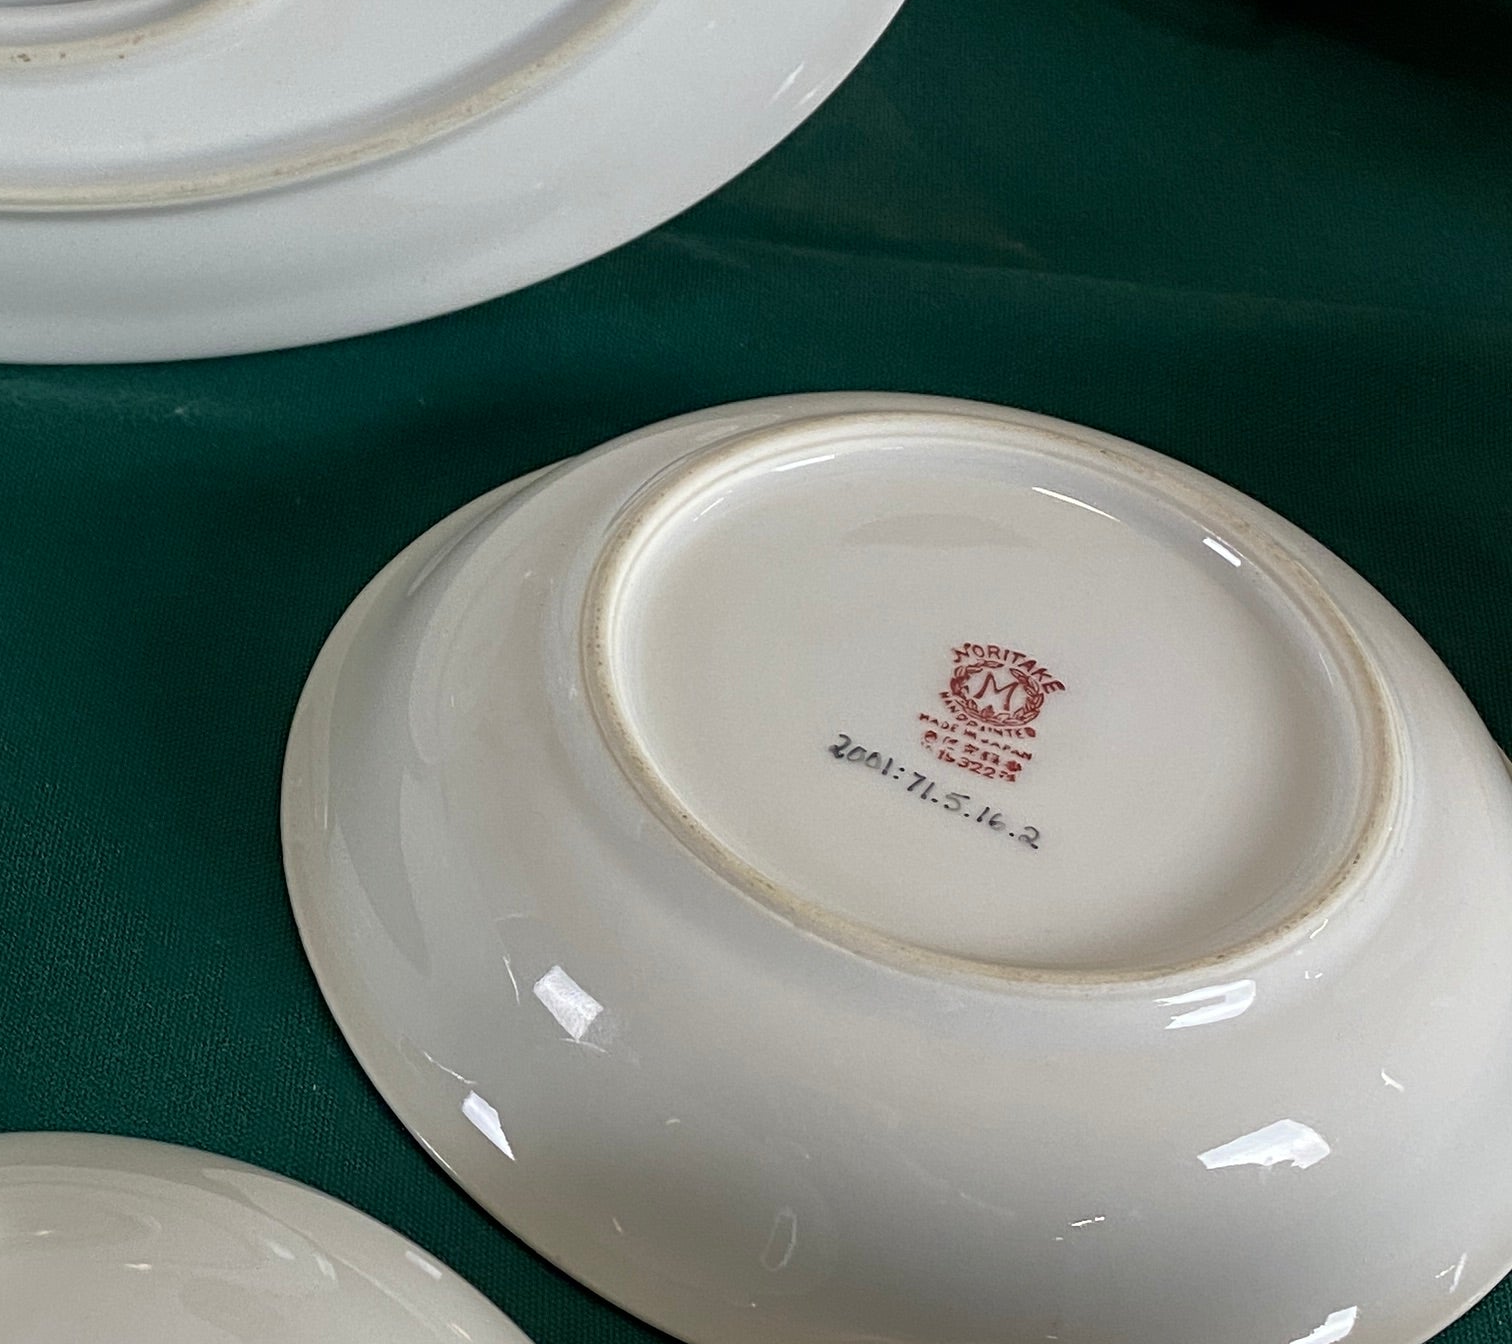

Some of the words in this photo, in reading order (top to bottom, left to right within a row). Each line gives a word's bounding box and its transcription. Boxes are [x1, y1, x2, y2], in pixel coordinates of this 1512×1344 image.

[951, 642, 1066, 695] NORITAKE
[973, 671, 1019, 711] M
[919, 713, 959, 733] MADE
